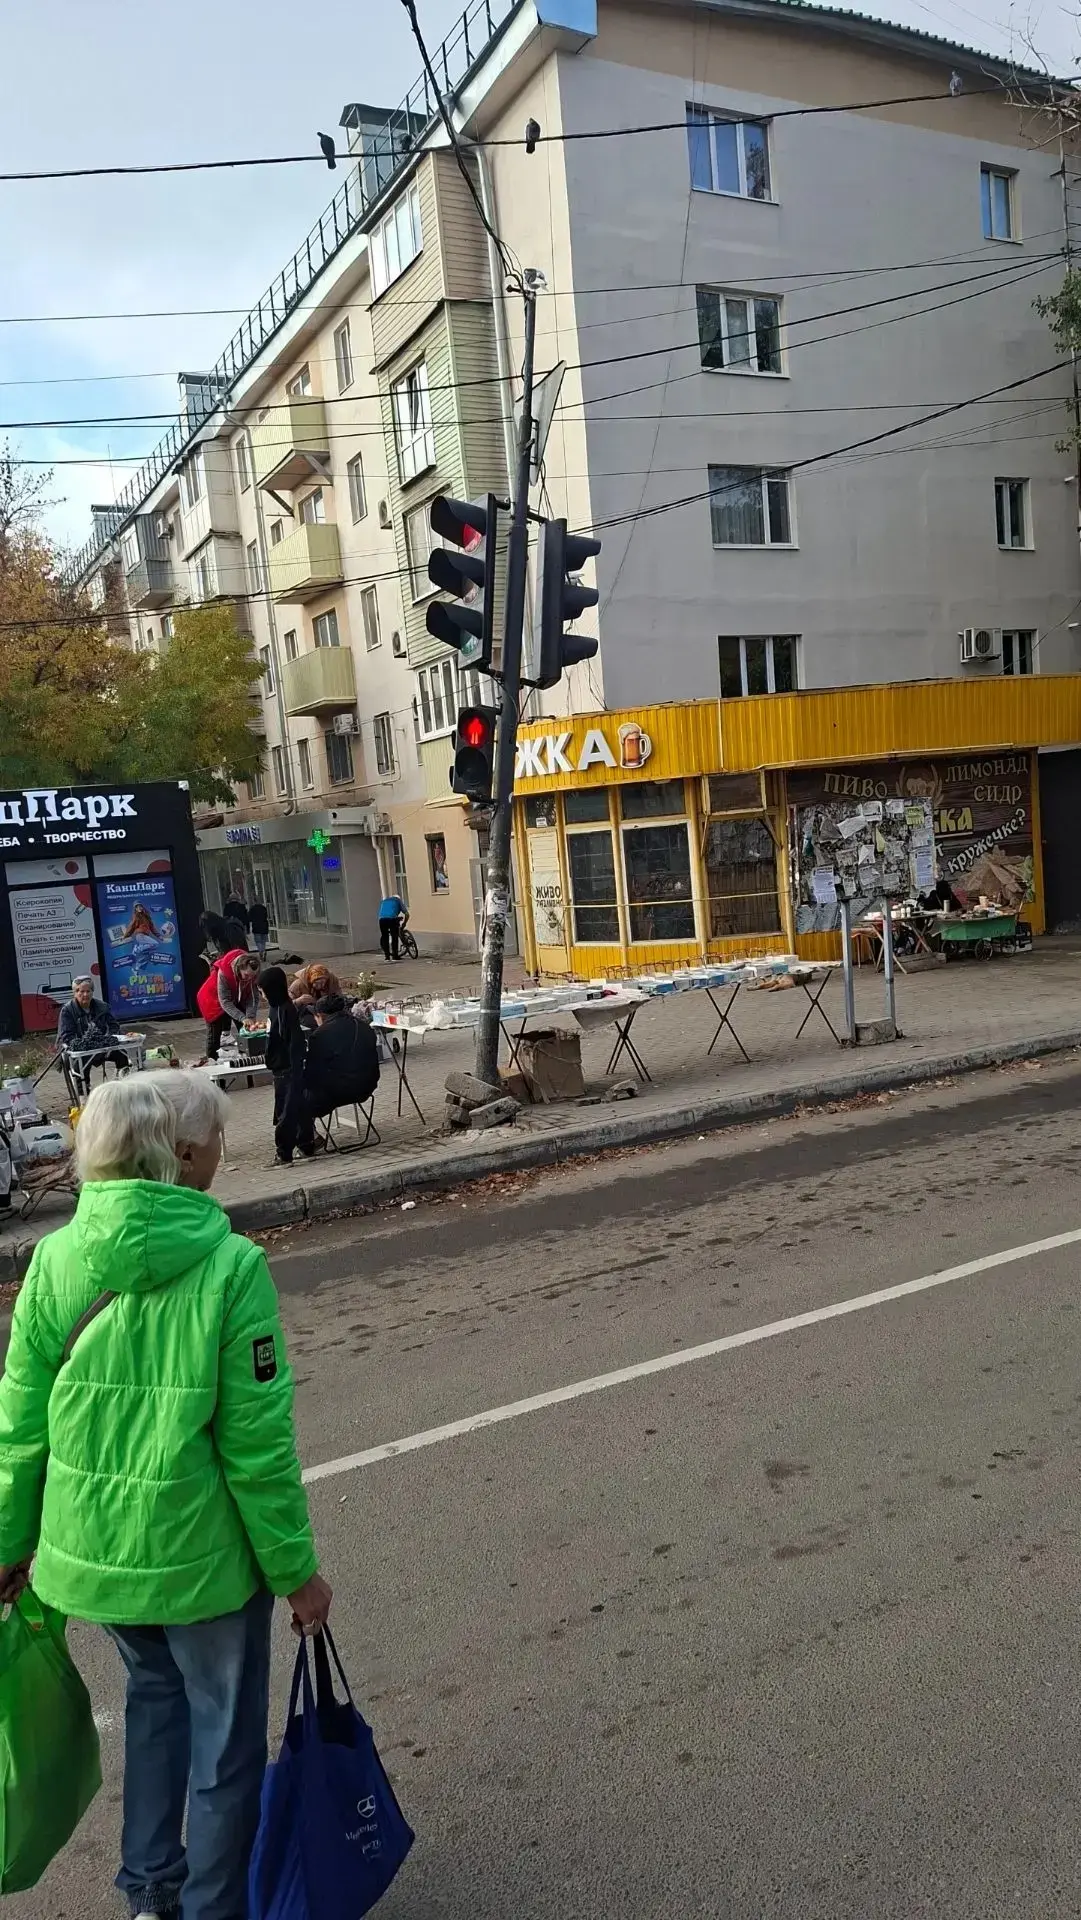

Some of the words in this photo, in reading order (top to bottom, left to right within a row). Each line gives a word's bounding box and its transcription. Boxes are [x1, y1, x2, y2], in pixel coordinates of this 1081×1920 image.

[945, 756, 1028, 782] ЛИМОНАД
[823, 772, 888, 798] ПИВО
[974, 785, 1022, 804] СИДР
[44, 829, 126, 844] ТВОРЧЕСТВО
[106, 882, 165, 893] КанцПарк
[16, 897, 63, 907] Ксерокопия
[18, 911, 45, 919] Печать
[19, 921, 74, 931] Сканирование
[21, 936, 47, 944] Печать
[56, 932, 91, 941] носителя
[22, 945, 83, 956] Ламинирование
[24, 960, 50, 968] Печать
[52, 958, 72, 967] фото
